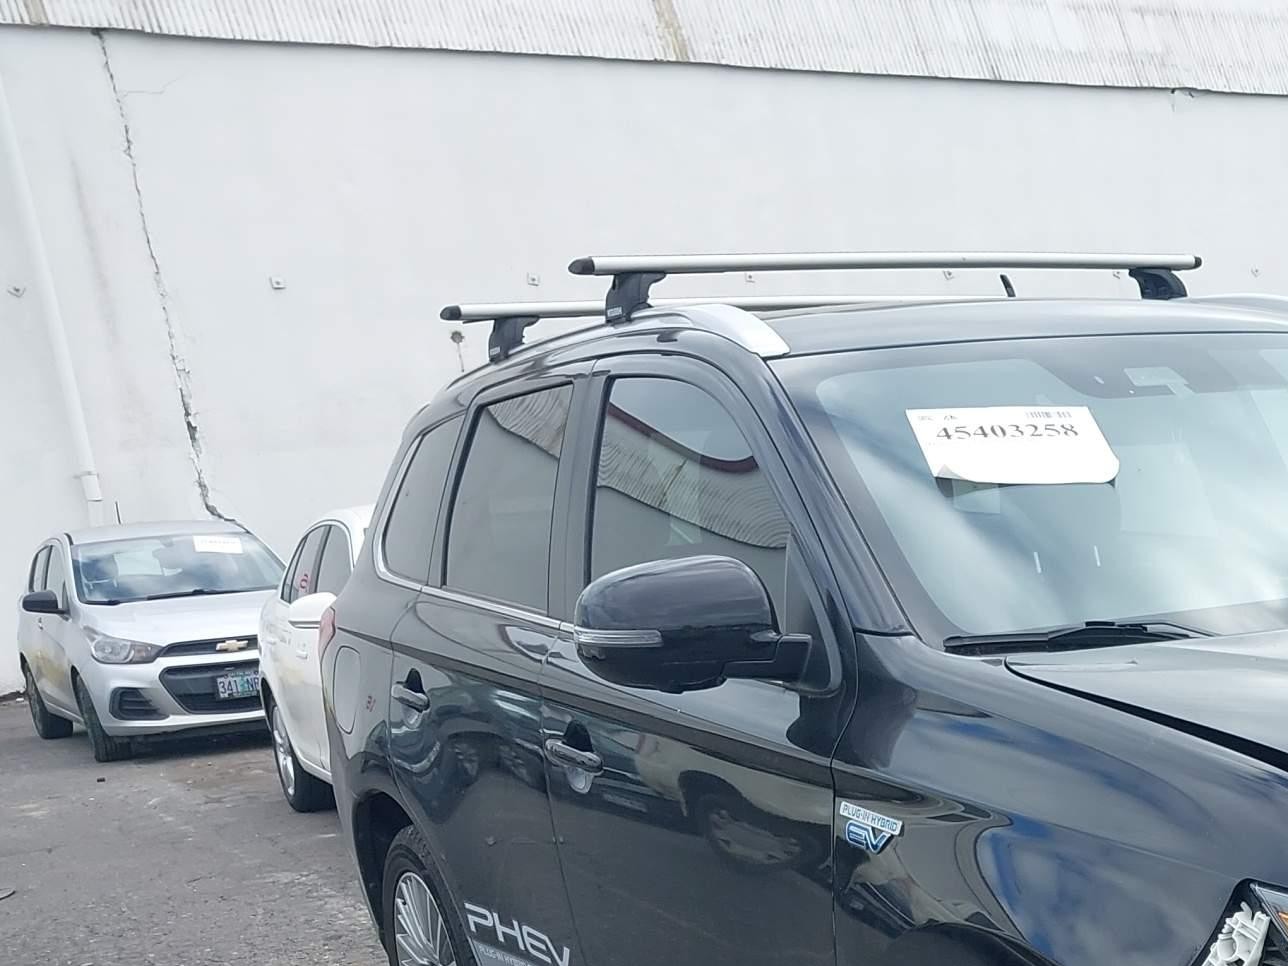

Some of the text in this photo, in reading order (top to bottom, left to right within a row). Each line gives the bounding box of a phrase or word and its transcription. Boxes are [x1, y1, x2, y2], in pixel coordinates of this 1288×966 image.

[936, 422, 1079, 441] 45403258
[218, 679, 240, 695] 341
[842, 804, 898, 832] PLUG-IN HYBRID
[846, 820, 891, 854] EV
